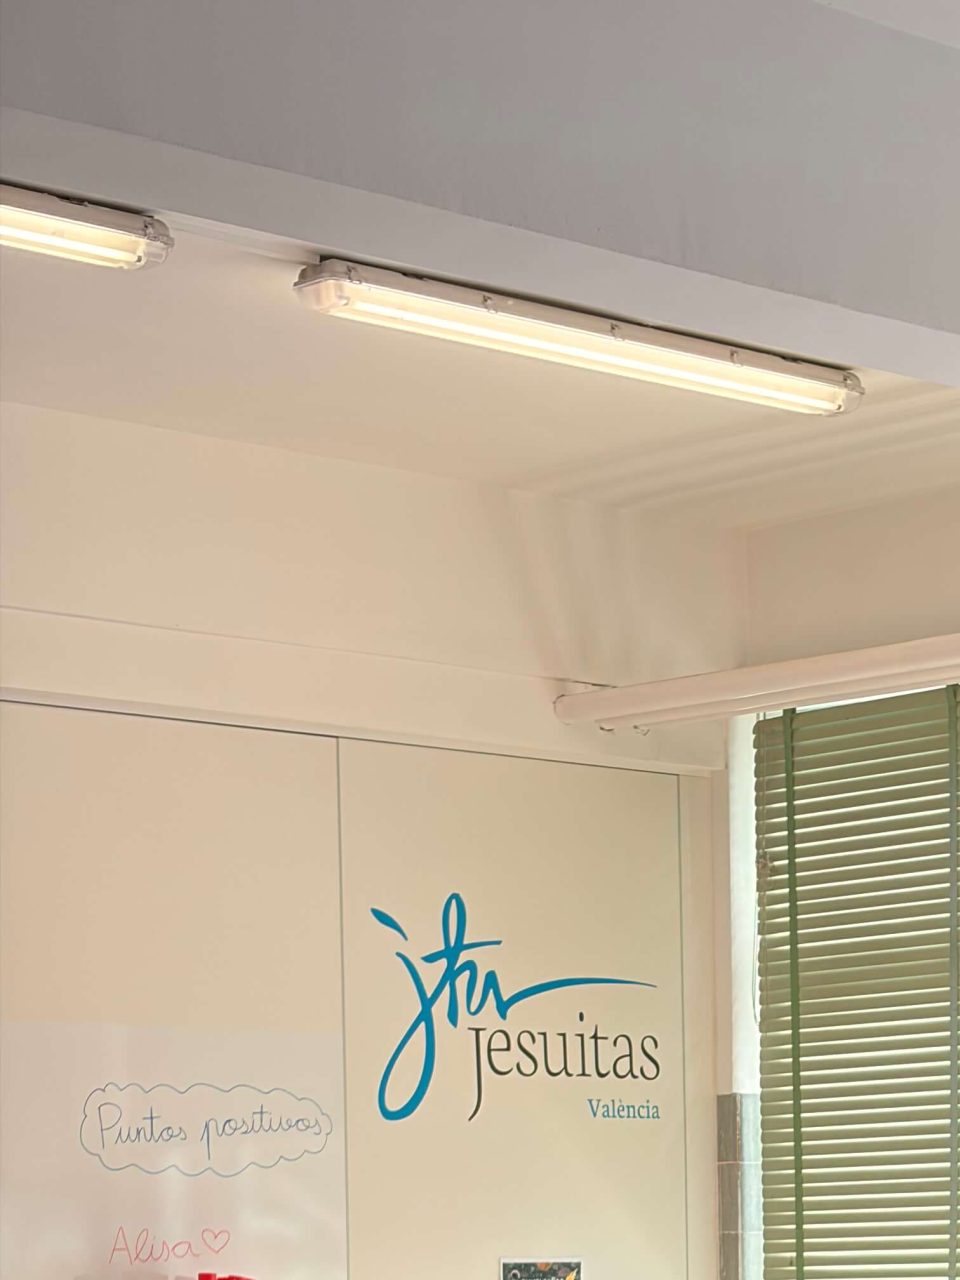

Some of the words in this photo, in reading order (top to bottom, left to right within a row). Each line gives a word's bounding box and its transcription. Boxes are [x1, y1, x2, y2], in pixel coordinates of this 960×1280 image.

[467, 1011, 660, 1122] Jesuitas
[98, 1102, 188, 1149] Puntos
[200, 1104, 322, 1160] positivos
[587, 1098, 660, 1119] València
[109, 1225, 200, 1265] Alisa
